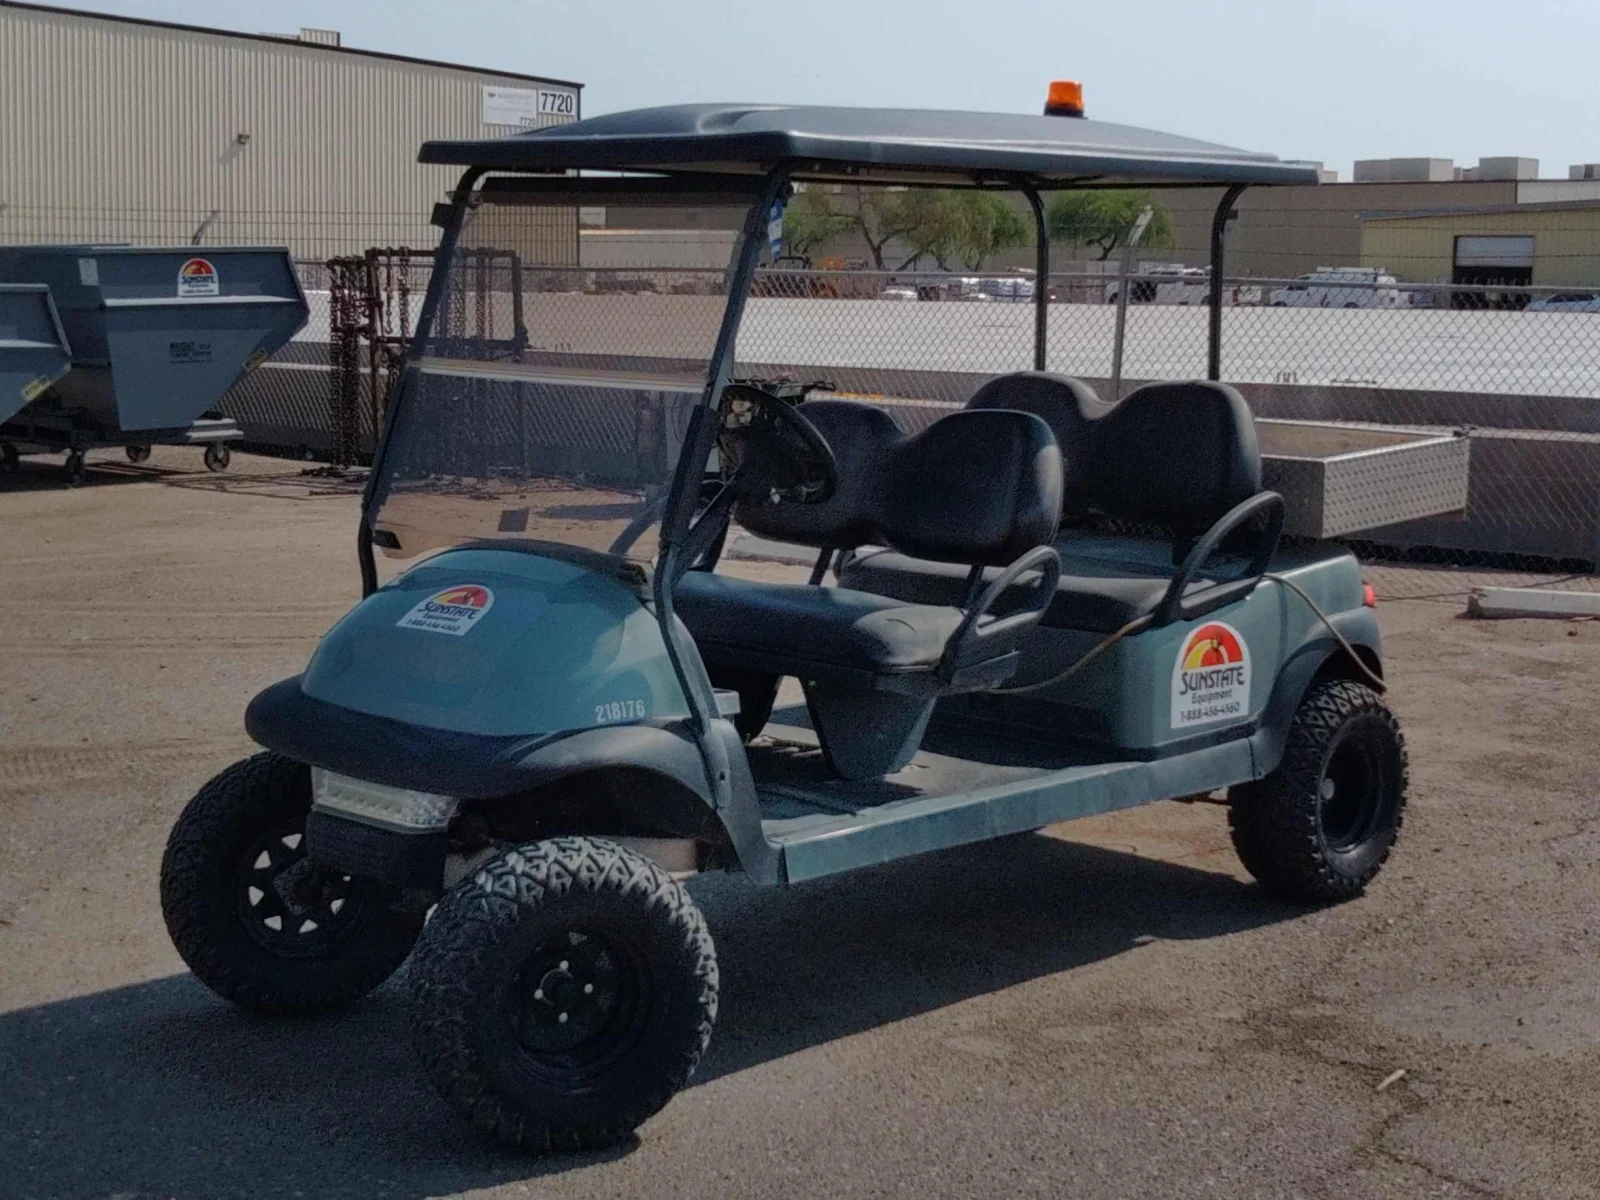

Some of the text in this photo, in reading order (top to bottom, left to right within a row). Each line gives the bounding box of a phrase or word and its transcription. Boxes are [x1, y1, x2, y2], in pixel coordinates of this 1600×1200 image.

[541, 92, 573, 114] 7720
[519, 116, 537, 126] 7720
[417, 601, 480, 619] SUNSTATE
[1179, 665, 1245, 696] SUNSTATE
[1191, 688, 1233, 705] Equipment
[594, 699, 646, 724] 218176
